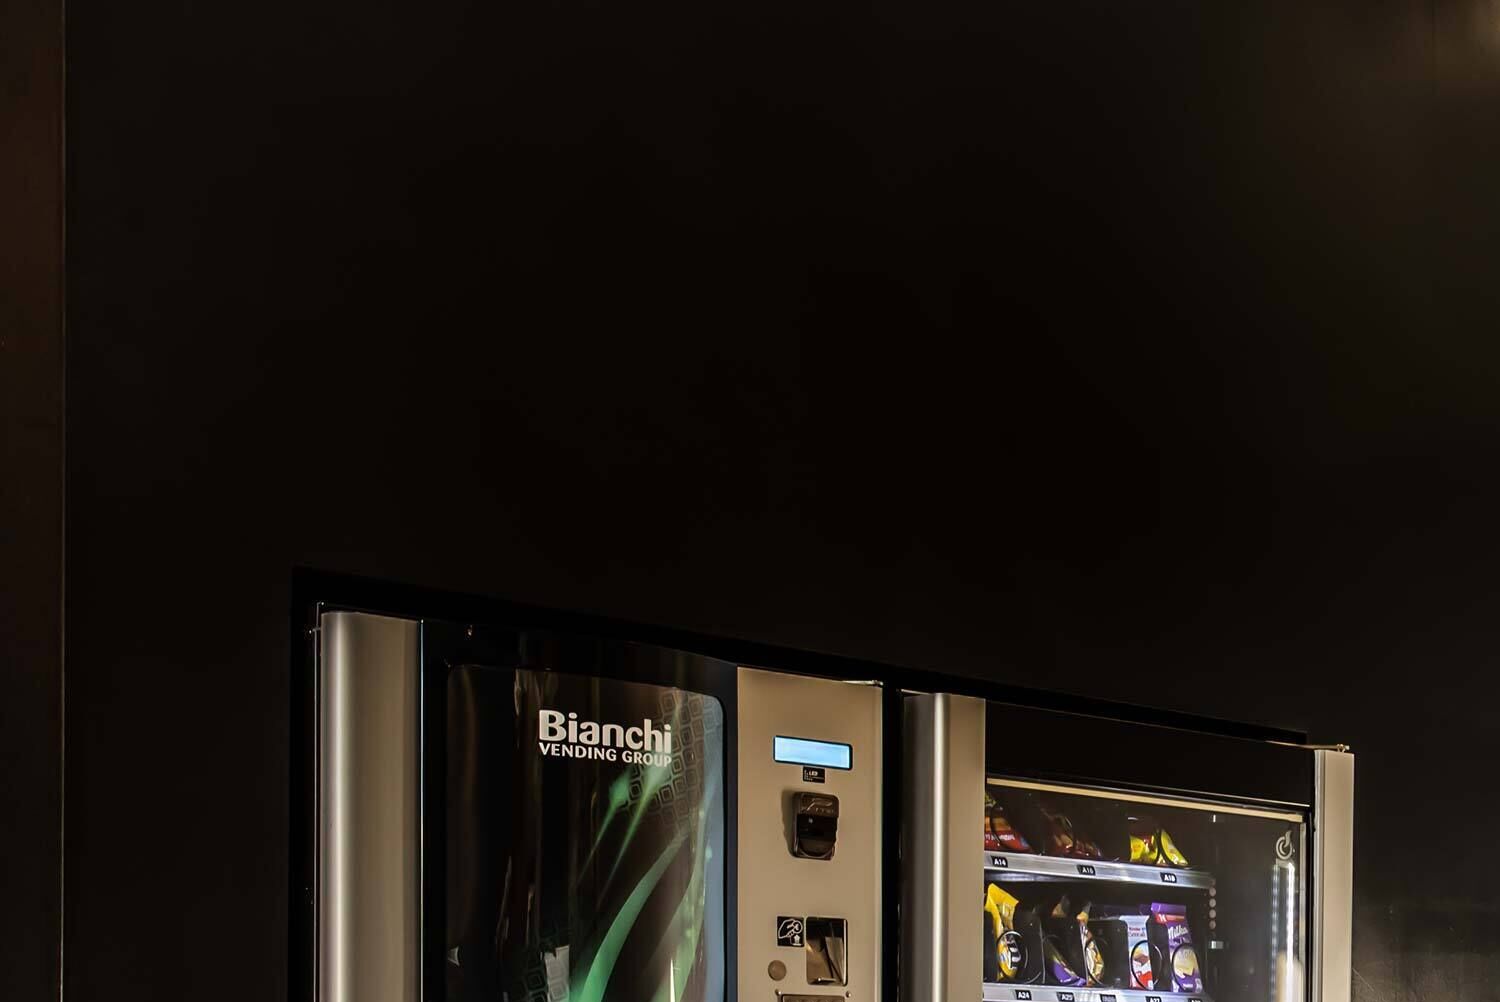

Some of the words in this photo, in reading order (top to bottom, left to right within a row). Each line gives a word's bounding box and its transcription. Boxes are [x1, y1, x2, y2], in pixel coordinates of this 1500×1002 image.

[539, 709, 672, 754] Bianchi
[539, 742, 617, 761] VENDING
[622, 751, 672, 768] GROUP
[1168, 924, 1189, 940] Milka
[1017, 991, 1029, 999] A24
